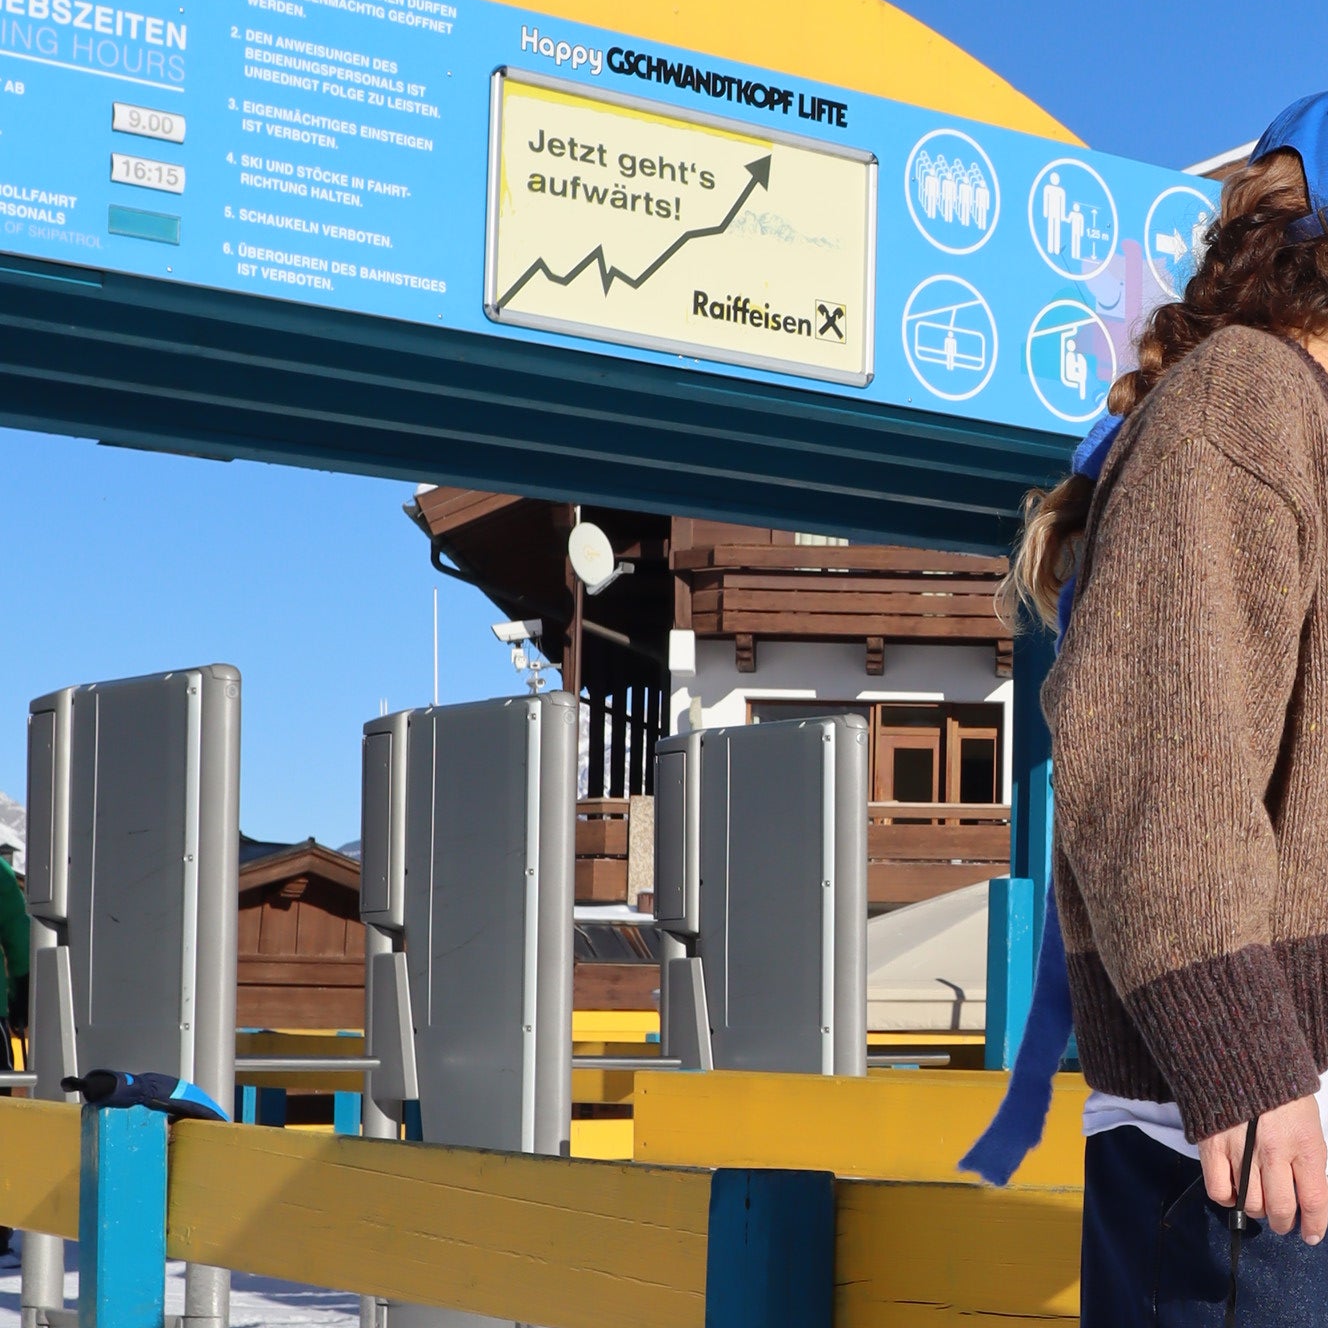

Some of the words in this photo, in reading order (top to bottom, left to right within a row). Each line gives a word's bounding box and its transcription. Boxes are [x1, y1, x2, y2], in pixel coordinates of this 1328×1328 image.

[388, 9, 454, 35] GEÖFFNET
[73, 33, 186, 82] HOURS
[231, 26, 241, 39] 2.
[246, 29, 273, 46] DEN
[275, 36, 370, 68] ANWEISUNGEN
[373, 57, 398, 74] DES
[4, 80, 25, 95] AB
[244, 65, 320, 92] UNBEDINGT
[322, 82, 365, 102] FOLGE
[368, 92, 385, 106] ZU
[387, 96, 441, 119] LEISTEN.
[245, 47, 404, 93] BEDIENUNGSPERSONALS
[407, 83, 426, 98] IST
[521, 25, 603, 75] Happy
[607, 47, 794, 114] GSCHWANDTKOPF
[798, 92, 848, 128] LIFTE
[129, 109, 173, 134] 9.00
[228, 97, 239, 111] 3.
[243, 100, 357, 136] EIGENMÄCHTIGES
[360, 125, 433, 151] EINSTEIGEN
[242, 119, 263, 133] IST
[266, 124, 339, 149] VERBOTEN.
[528, 129, 607, 168] Jetzt
[121, 159, 179, 186] 16:15
[226, 152, 236, 165] 4.
[241, 154, 262, 169] SKI
[266, 159, 293, 175] UND
[296, 165, 348, 187] STÖCKE
[352, 176, 365, 190] IN
[367, 180, 411, 199] FAHRT-
[240, 172, 307, 196] RICHTUNG
[311, 185, 363, 207] HALTEN.
[0, 184, 77, 209] OLLFAHRT
[527, 172, 681, 221] aufwärts!
[5, 221, 24, 234] OF
[224, 206, 235, 219] 5.
[239, 208, 319, 234] SCHAUKELN
[322, 224, 394, 248] VERBOTEN.
[223, 242, 234, 255] 6.
[238, 242, 328, 272] ÜBERQUEREN
[331, 261, 357, 277] DES
[360, 267, 447, 293] BAHNSTEIGES
[237, 263, 258, 277] IST
[261, 267, 334, 291] VERBOTEN.
[692, 290, 811, 336] Raiffeisen
